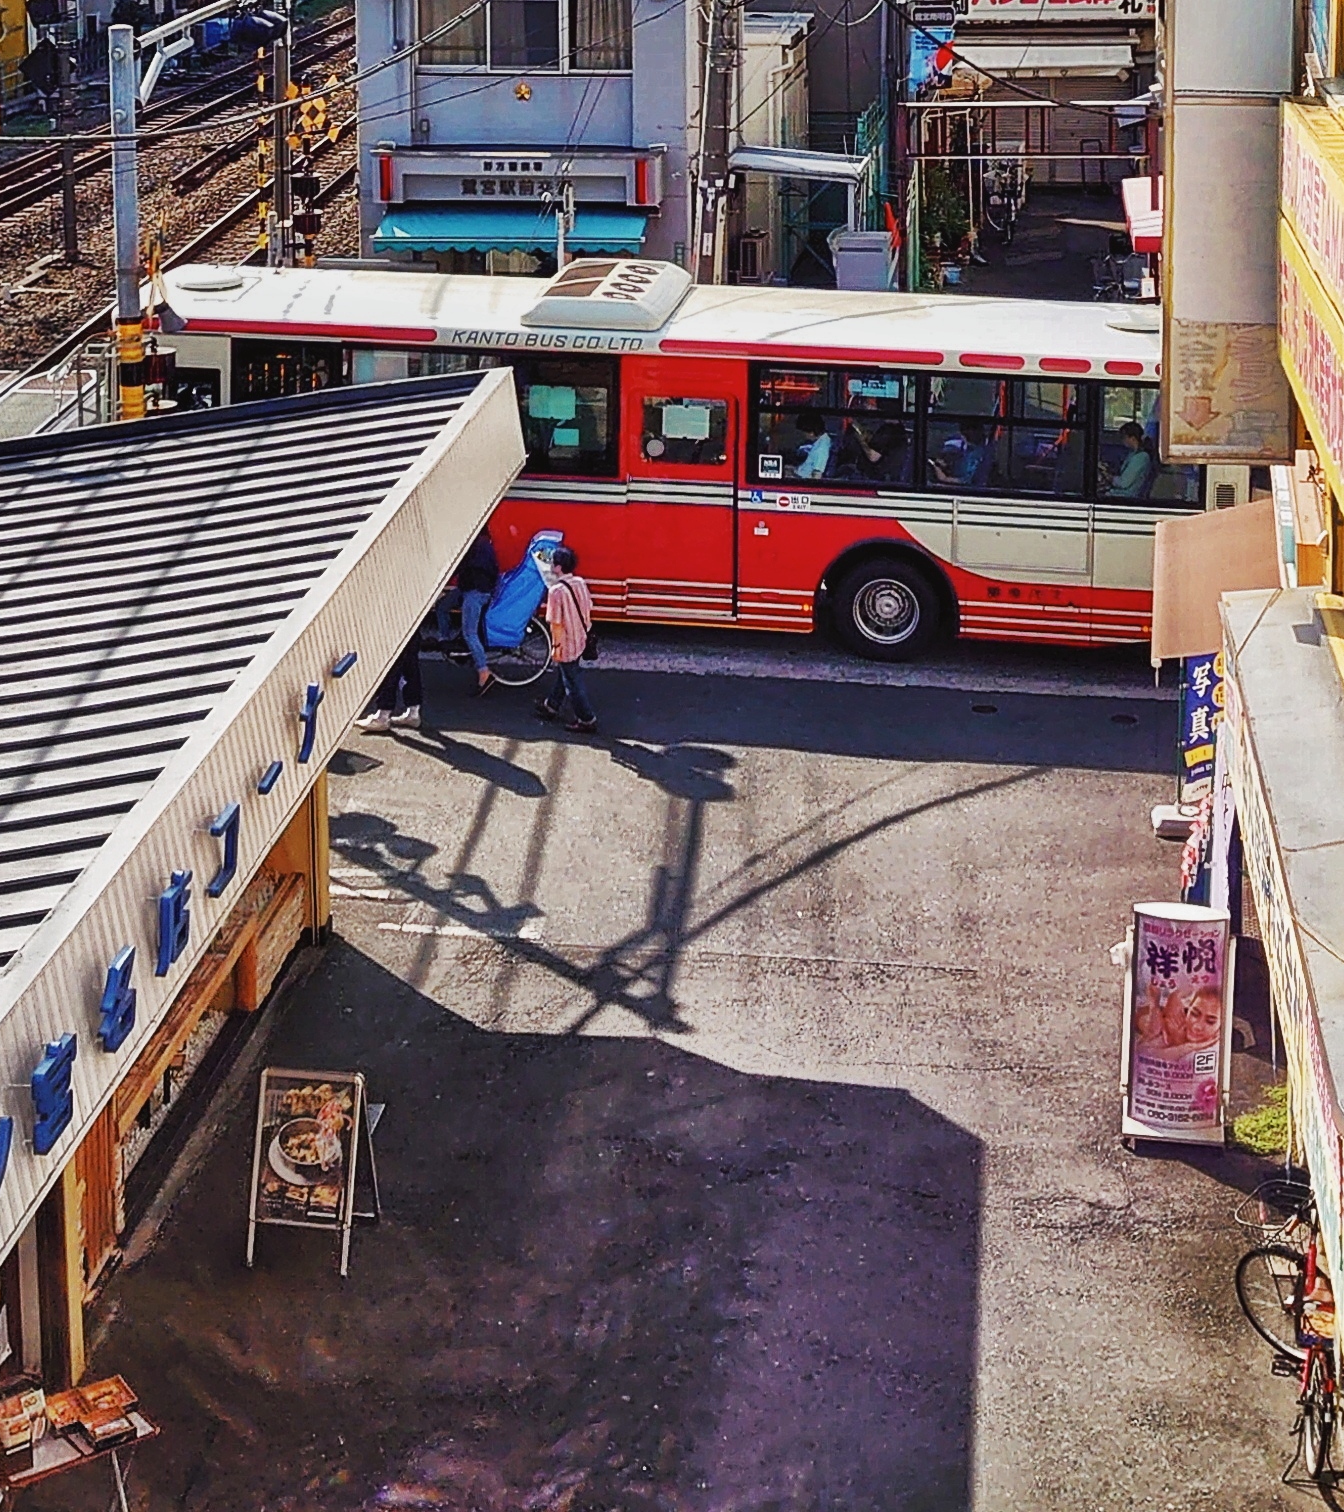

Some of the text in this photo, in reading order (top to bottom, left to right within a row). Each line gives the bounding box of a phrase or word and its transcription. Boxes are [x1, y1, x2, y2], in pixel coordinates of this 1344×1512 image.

[451, 329, 519, 346] KANTO
[524, 333, 568, 347] BUS
[1189, 659, 1213, 745] 写真
[1196, 1054, 1214, 1066] 2F
